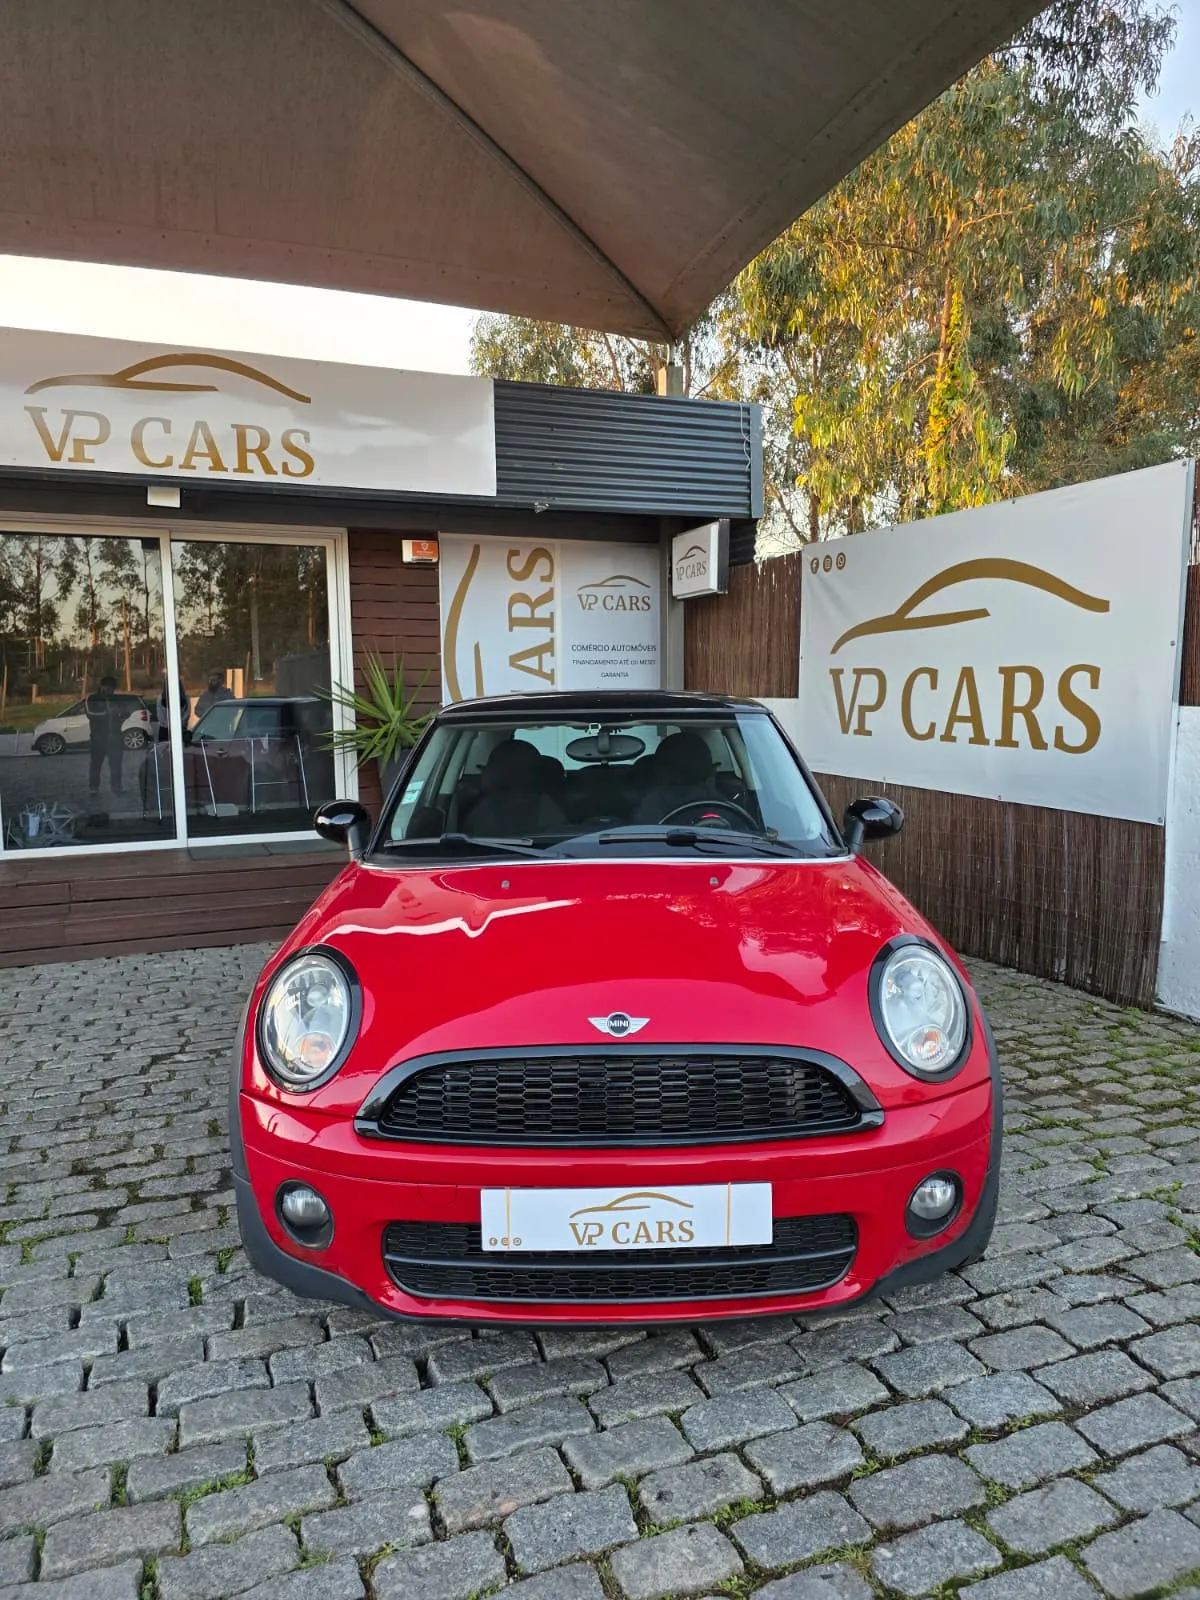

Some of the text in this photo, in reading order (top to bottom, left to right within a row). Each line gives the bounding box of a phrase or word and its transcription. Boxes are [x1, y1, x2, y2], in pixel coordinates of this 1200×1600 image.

[23, 406, 316, 478] VP CARS
[676, 561, 707, 581] VP CARS
[577, 594, 652, 612] VP CARS
[507, 546, 556, 691] ARS
[571, 642, 657, 652] COMÉRCIO AUTOMÓVEIS
[829, 664, 1102, 755] VP CARS
[569, 1220, 695, 1246] VP CARS
